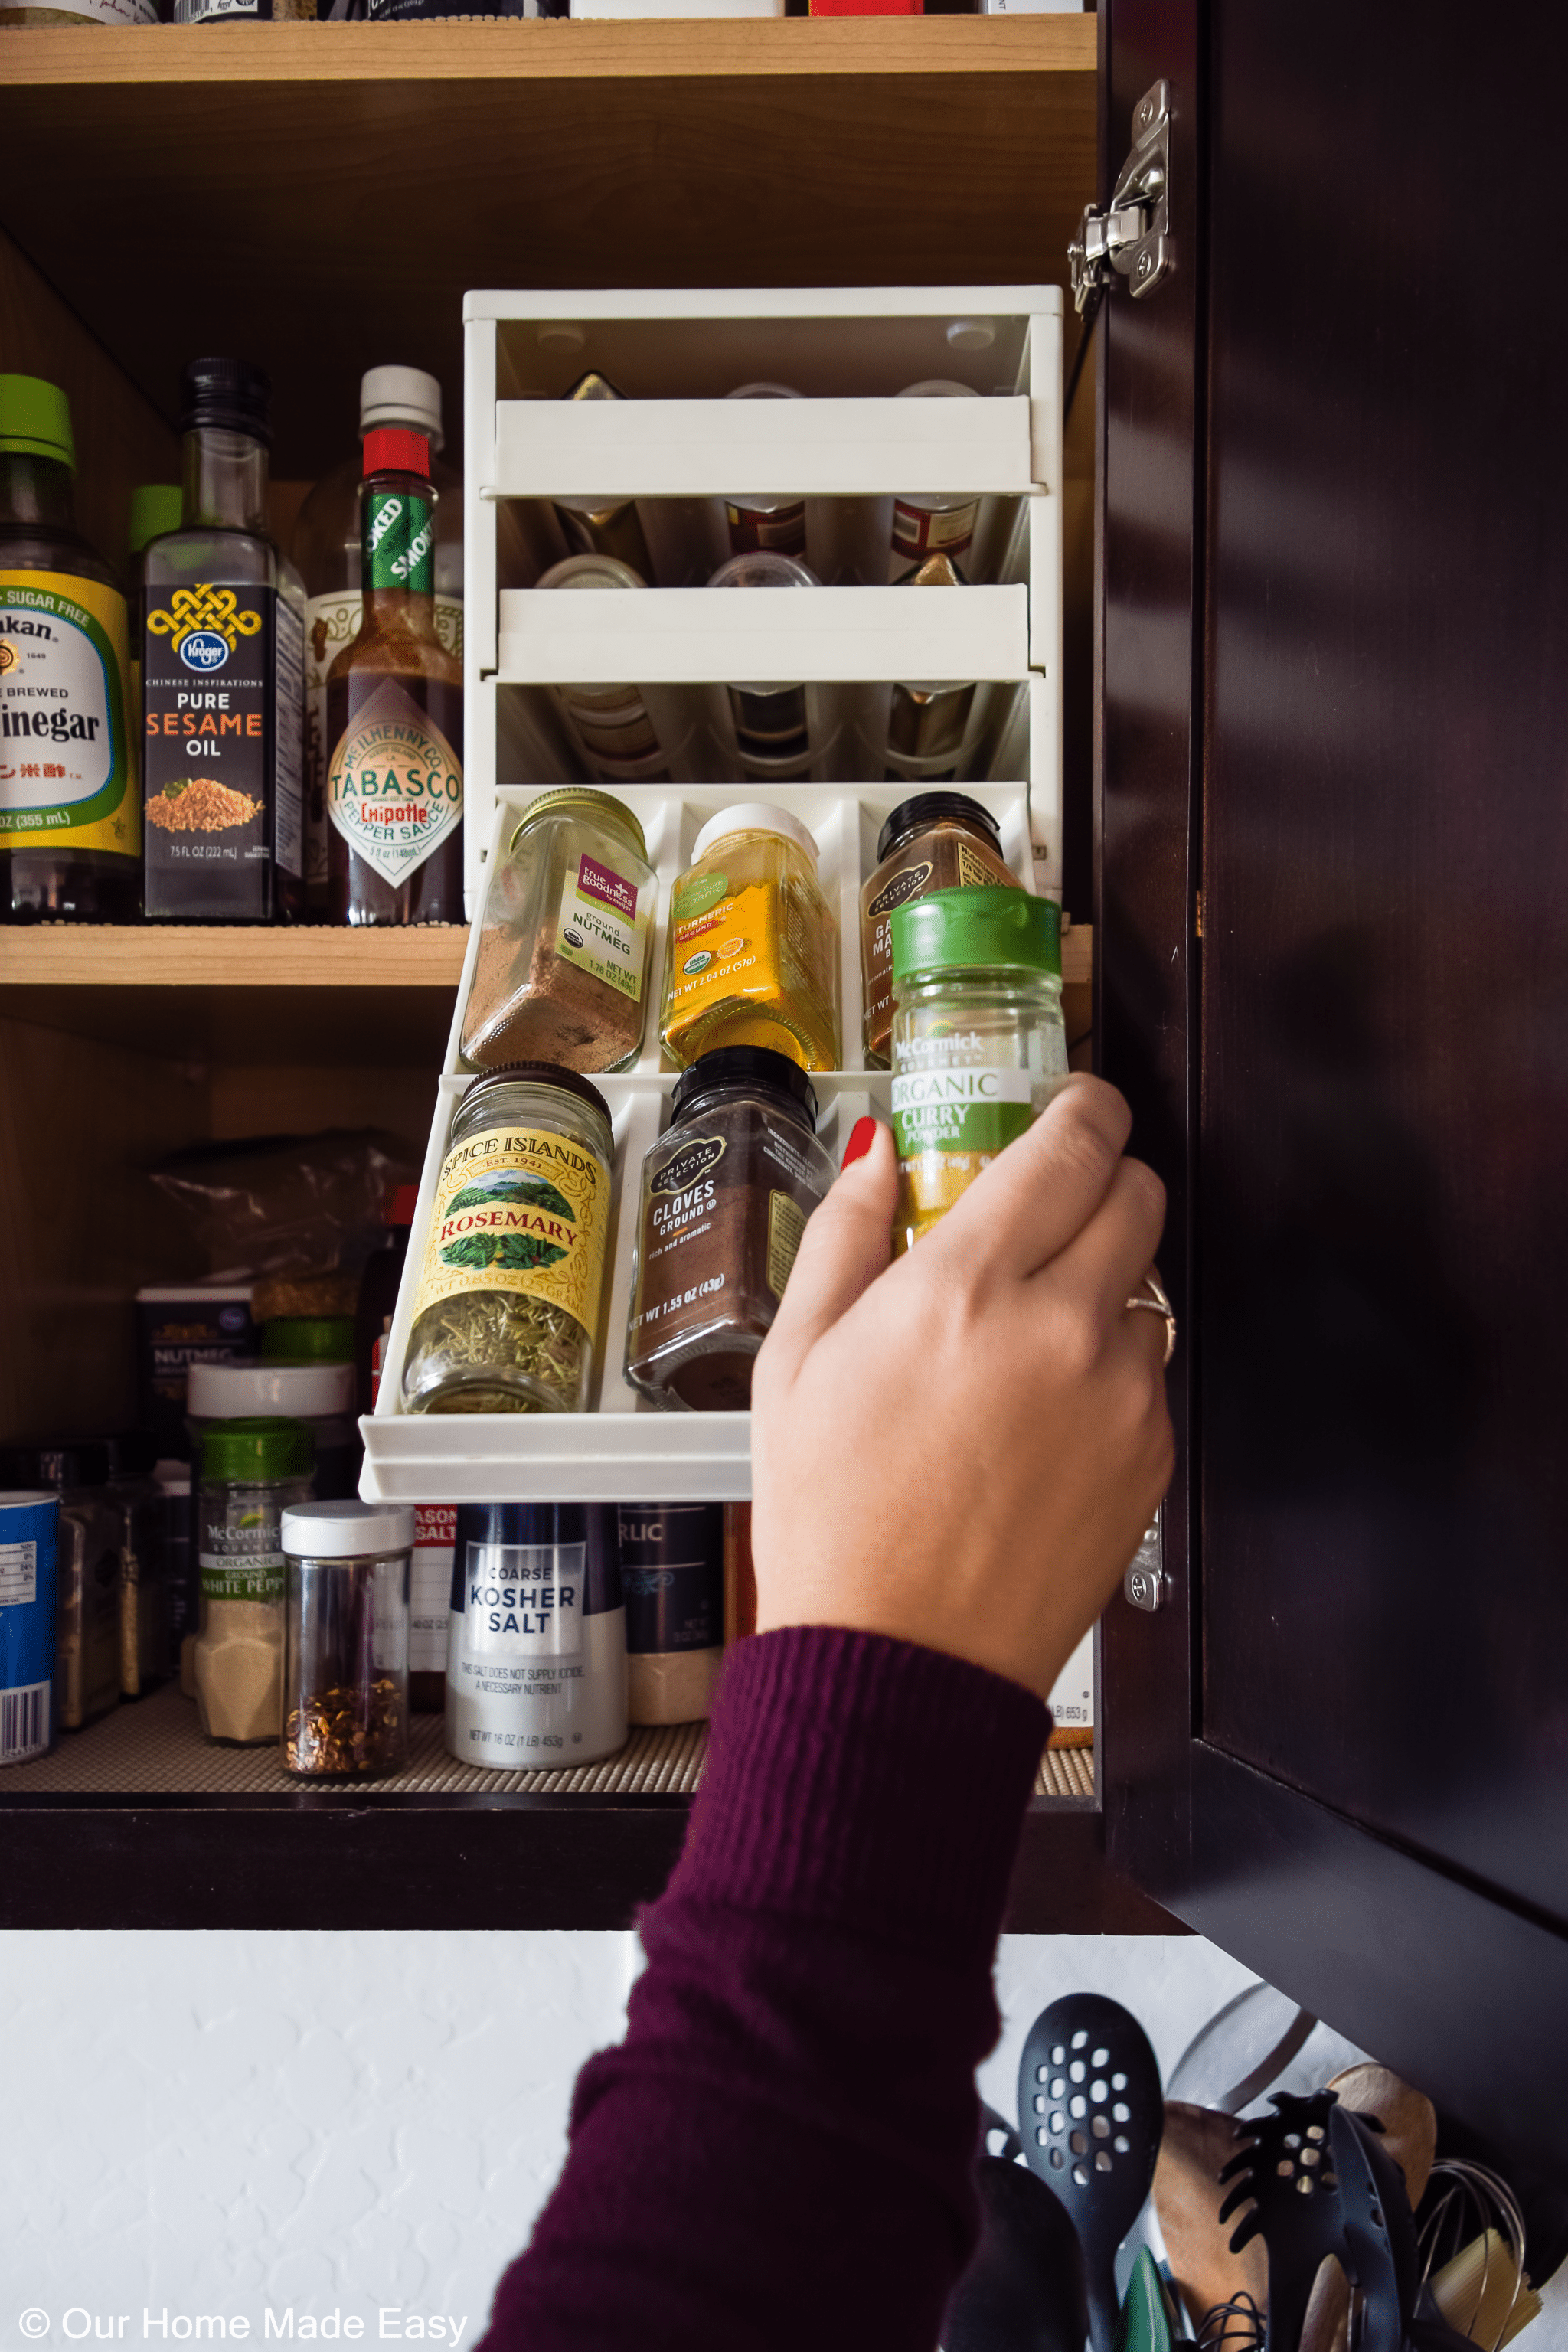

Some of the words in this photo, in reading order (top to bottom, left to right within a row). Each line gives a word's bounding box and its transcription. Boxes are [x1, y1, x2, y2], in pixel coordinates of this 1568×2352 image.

[7, 590, 54, 610] SUGAR
[57, 600, 90, 628] FREE
[0, 615, 51, 640] kan
[188, 639, 223, 665] Kroger
[7, 687, 69, 698] BREWED
[146, 678, 189, 687] CHINESE
[193, 679, 263, 688] INSPIRATIONS
[177, 692, 230, 710] PURE
[2, 703, 100, 743] inegar
[146, 713, 263, 737] SESAME
[185, 739, 221, 756] OIL
[331, 768, 459, 802] TABASCO
[16, 814, 43, 829] (355
[46, 810, 70, 826] mL)
[345, 800, 394, 840] PEPPER
[400, 799, 445, 840] SAUCE
[361, 802, 427, 826] Chipotle
[181, 845, 190, 857] FL
[192, 846, 204, 857] OZ
[205, 846, 221, 860] (222
[223, 846, 237, 860] mL)
[583, 866, 606, 885] true
[582, 874, 633, 907] goodness
[874, 874, 924, 913] SELECTION
[875, 870, 921, 906] PRIVATE
[612, 897, 632, 912] meijer
[586, 911, 620, 936] ground
[677, 903, 733, 933] TURMERIC
[875, 918, 892, 940] GA
[573, 912, 631, 956] NUTMEG
[678, 921, 712, 941] GROUND
[873, 934, 893, 957] MA
[590, 959, 604, 975] 1.76
[606, 969, 617, 983] OZ
[606, 959, 622, 973] NET
[623, 967, 638, 984] WT
[689, 954, 706, 966] USDA
[668, 987, 682, 1001] NET
[684, 980, 697, 993] WT
[699, 971, 717, 985] 2.04
[720, 965, 731, 977] OZ
[733, 955, 756, 972] (57g)
[877, 995, 890, 1009] WT
[895, 1031, 985, 1060] McCormick
[893, 1073, 998, 1106] ORGANIC
[901, 1103, 970, 1131] CURRY
[906, 1125, 960, 1143] POWDER
[441, 1138, 498, 1182] SPICE
[503, 1136, 597, 1185] ISLANDS
[513, 1156, 543, 1169] 1941
[657, 1152, 715, 1187] SELECTION
[659, 1146, 712, 1180] PRIVATE
[652, 1178, 714, 1227] CLOVES
[439, 1210, 579, 1247] ROSEMARY
[659, 1203, 704, 1236] GROUND
[648, 1247, 663, 1260] rich
[664, 1237, 678, 1253] and
[679, 1221, 711, 1244] aromatic
[495, 1273, 518, 1285] OZ
[645, 1307, 661, 1324] WT
[662, 1296, 682, 1315] 1.55
[684, 1289, 697, 1305] OZ
[698, 1272, 725, 1298] (43g)
[207, 1524, 279, 1540] McCormic
[414, 1526, 457, 1540] SALT
[612, 1523, 664, 1542] RLIC
[215, 1557, 276, 1568] ORGANIC
[224, 1569, 267, 1580] GROUND
[489, 1567, 552, 1581] COARSE
[201, 1579, 242, 1593] WHITE
[246, 1576, 285, 1593] PEPP
[470, 1584, 575, 1609] KOSHER
[488, 1612, 550, 1634] SALT
[472, 1664, 488, 1677] SALT
[489, 1667, 508, 1680] DOES
[509, 1668, 526, 1681] NOT
[527, 1668, 556, 1681] SUPPLY
[475, 1680, 481, 1690] A
[481, 1681, 523, 1695] NECESSARY
[524, 1683, 562, 1696] NUTRIENT
[469, 1728, 481, 1741] NET
[480, 1730, 492, 1743] WT
[494, 1733, 501, 1744] 16
[504, 1733, 515, 1746] OZ
[517, 1734, 525, 1747] (1
[541, 1735, 564, 1749] 453g
